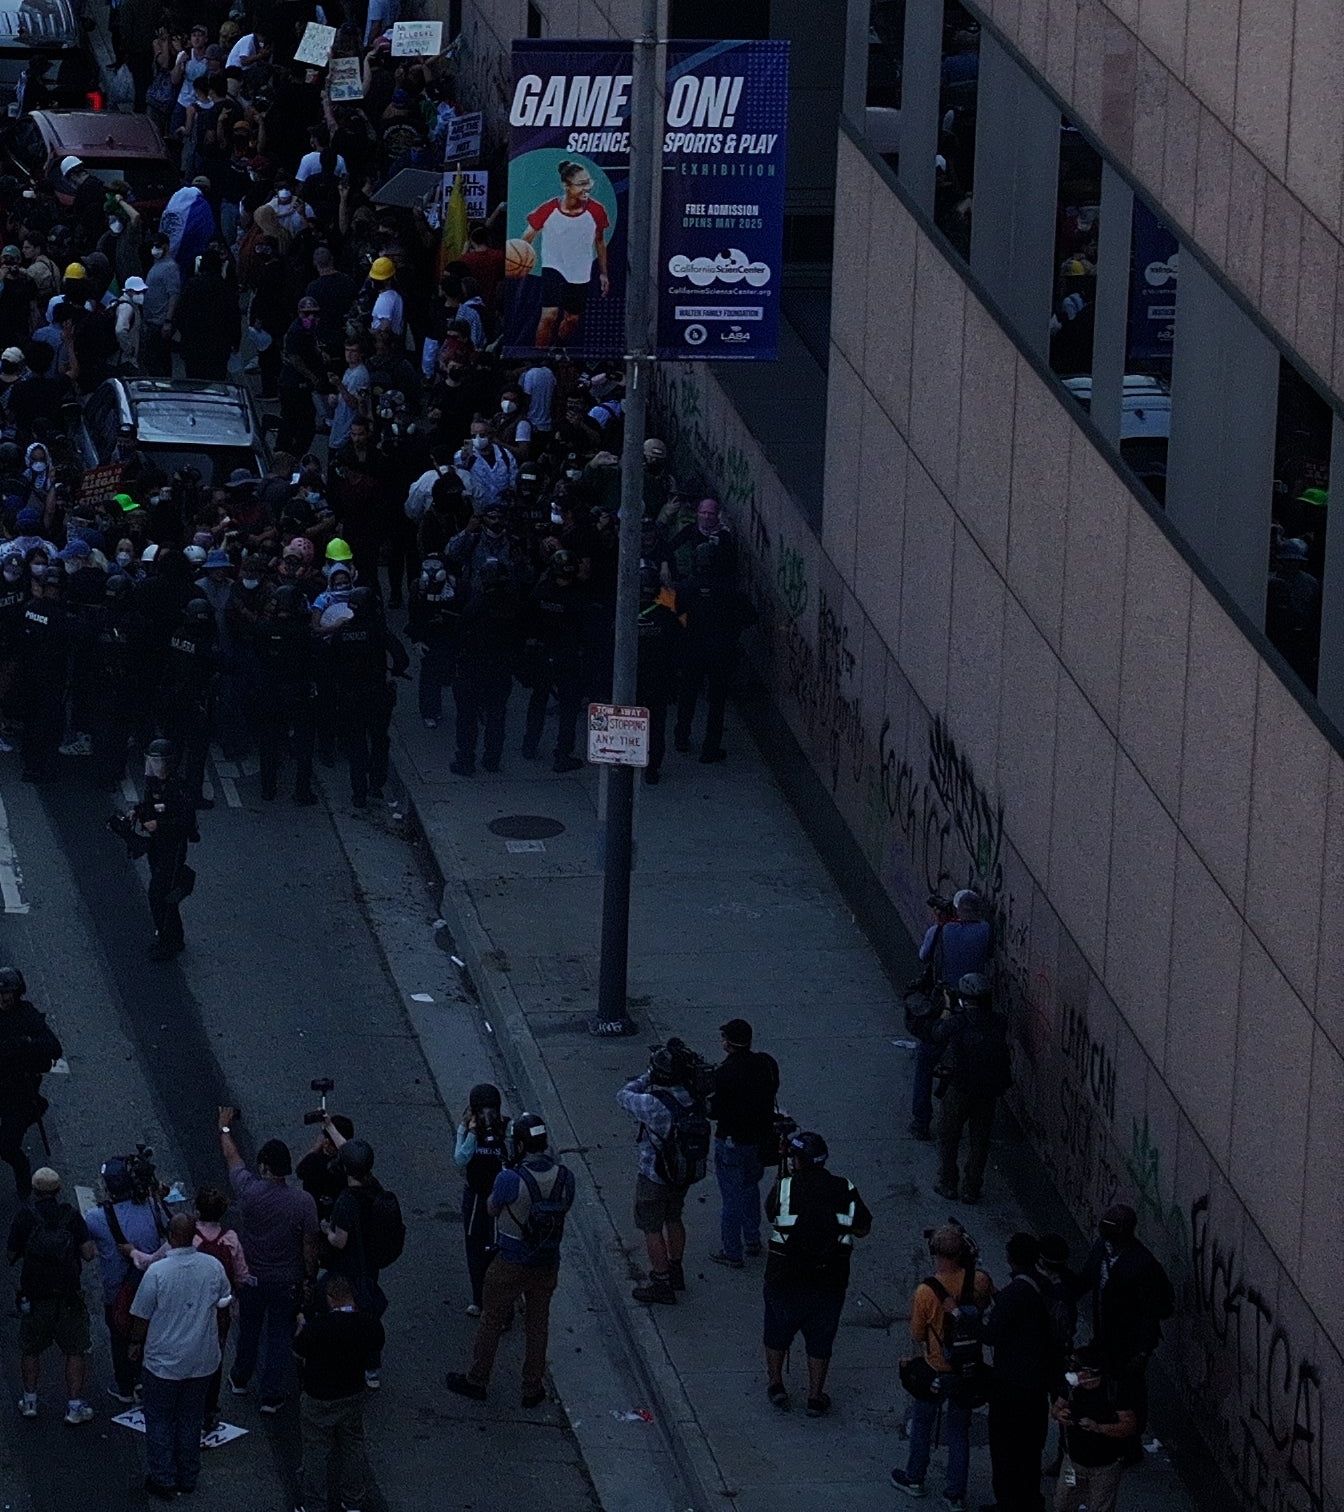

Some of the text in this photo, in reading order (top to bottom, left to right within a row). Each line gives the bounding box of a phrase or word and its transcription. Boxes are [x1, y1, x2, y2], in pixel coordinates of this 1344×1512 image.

[509, 74, 744, 128] GAME ON!
[566, 132, 778, 154] SCIENCE, SPORTS & PLAY
[680, 163, 776, 176] EXHIBITION
[445, 185, 485, 197] RHTS
[685, 204, 759, 216] FREE ADMISSION
[683, 218, 762, 229] OPENS MAY 2025
[25, 610, 49, 625] POLICE
[609, 719, 646, 731] STOPPING
[596, 734, 641, 747] ANY TIME
